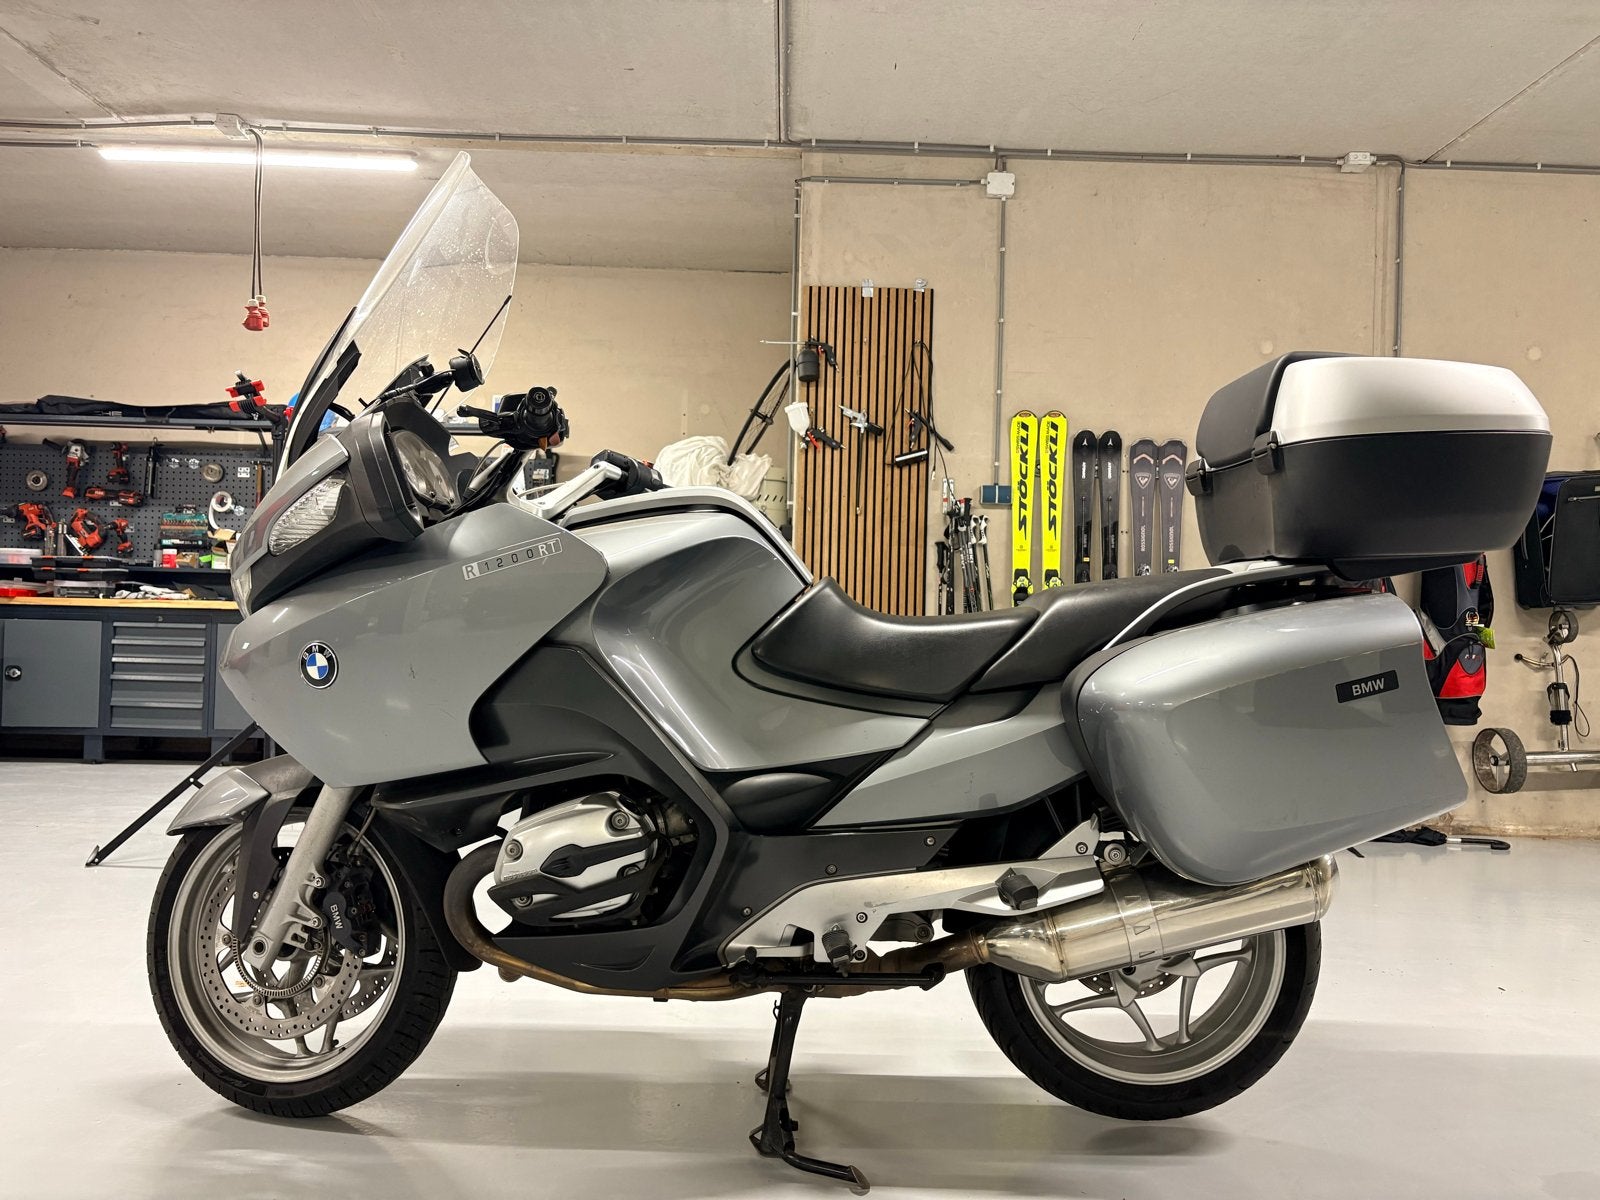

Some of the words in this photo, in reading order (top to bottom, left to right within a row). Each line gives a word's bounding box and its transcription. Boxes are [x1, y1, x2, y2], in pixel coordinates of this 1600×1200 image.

[1018, 420, 1029, 540] STÖCKLI
[1047, 420, 1059, 540] STÖCKLI
[1352, 677, 1385, 697] BMW
[330, 904, 344, 929] BMW
